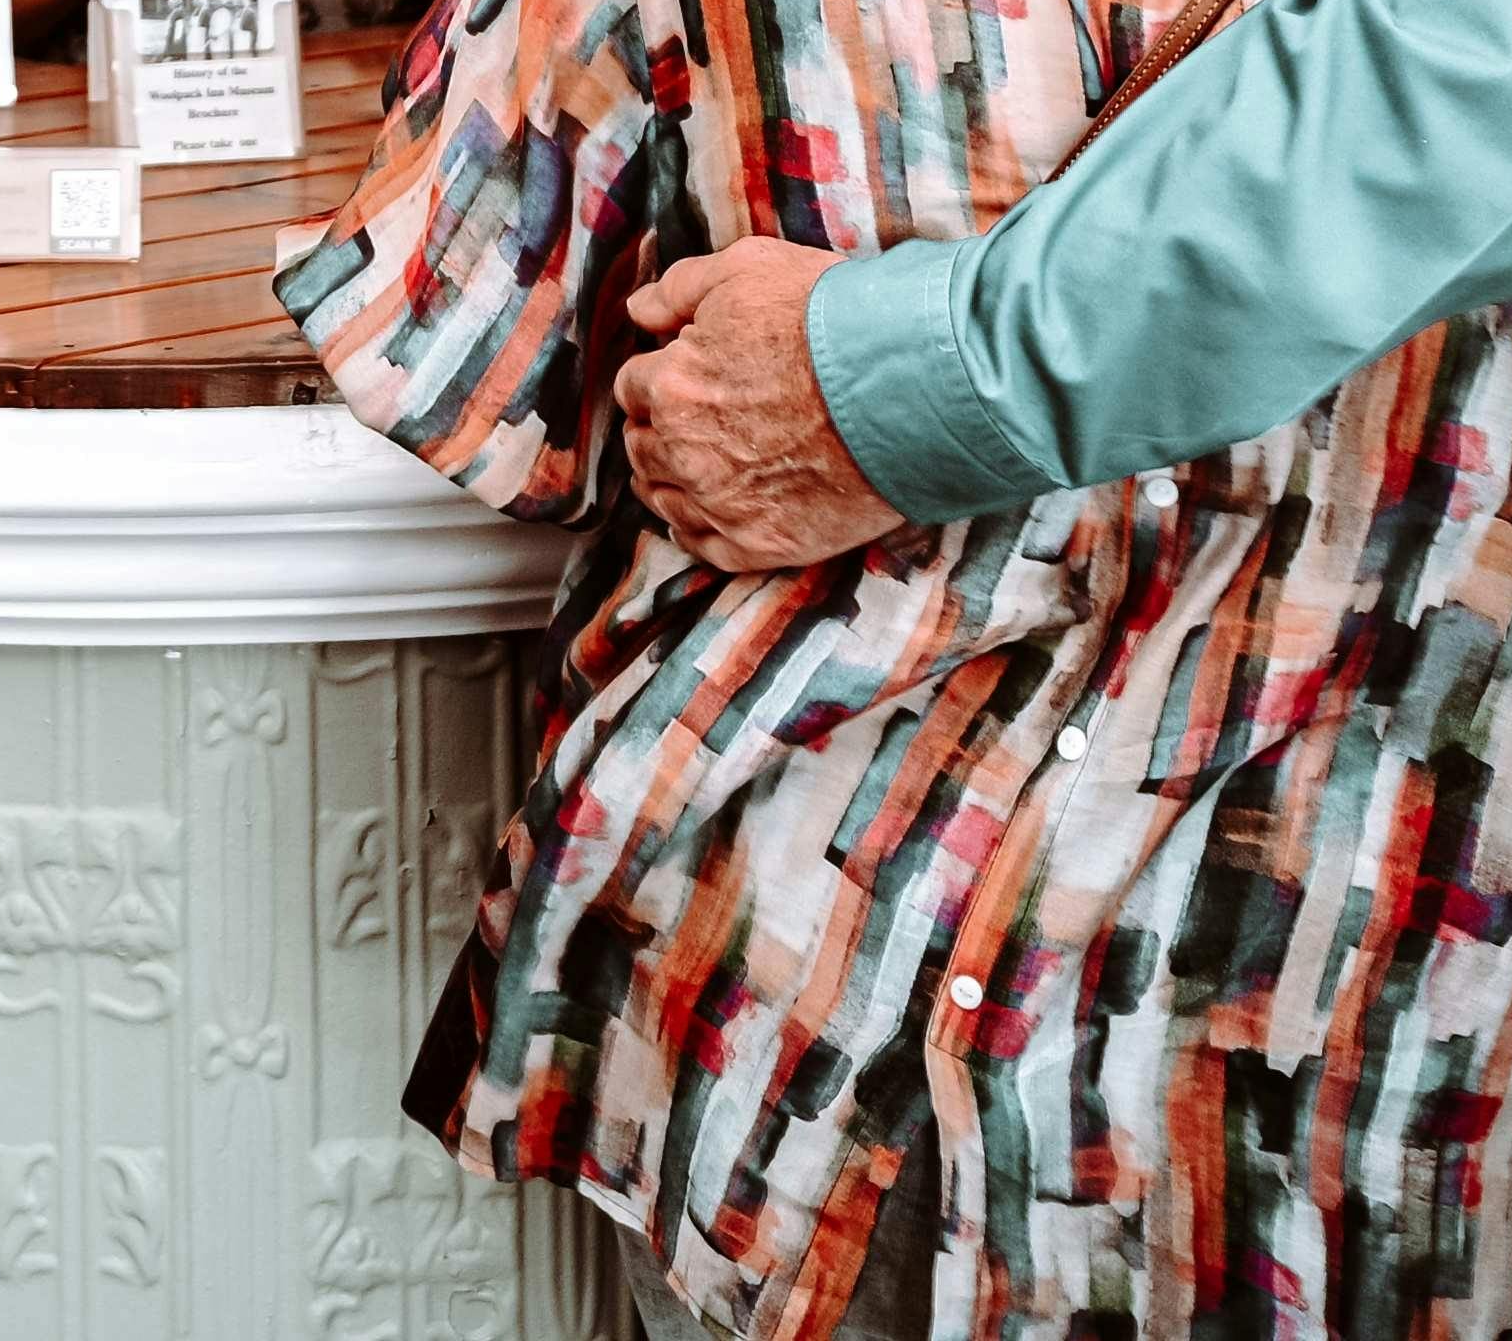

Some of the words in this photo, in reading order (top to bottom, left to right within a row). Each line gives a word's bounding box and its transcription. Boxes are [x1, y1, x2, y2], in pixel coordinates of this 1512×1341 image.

[173, 67, 213, 79] History
[231, 66, 249, 76] the
[148, 88, 203, 101] Woolpack
[206, 87, 225, 98] Inn
[229, 85, 275, 96] Museum
[187, 107, 240, 119] Brochure
[172, 139, 207, 151] Please
[209, 137, 234, 149] take
